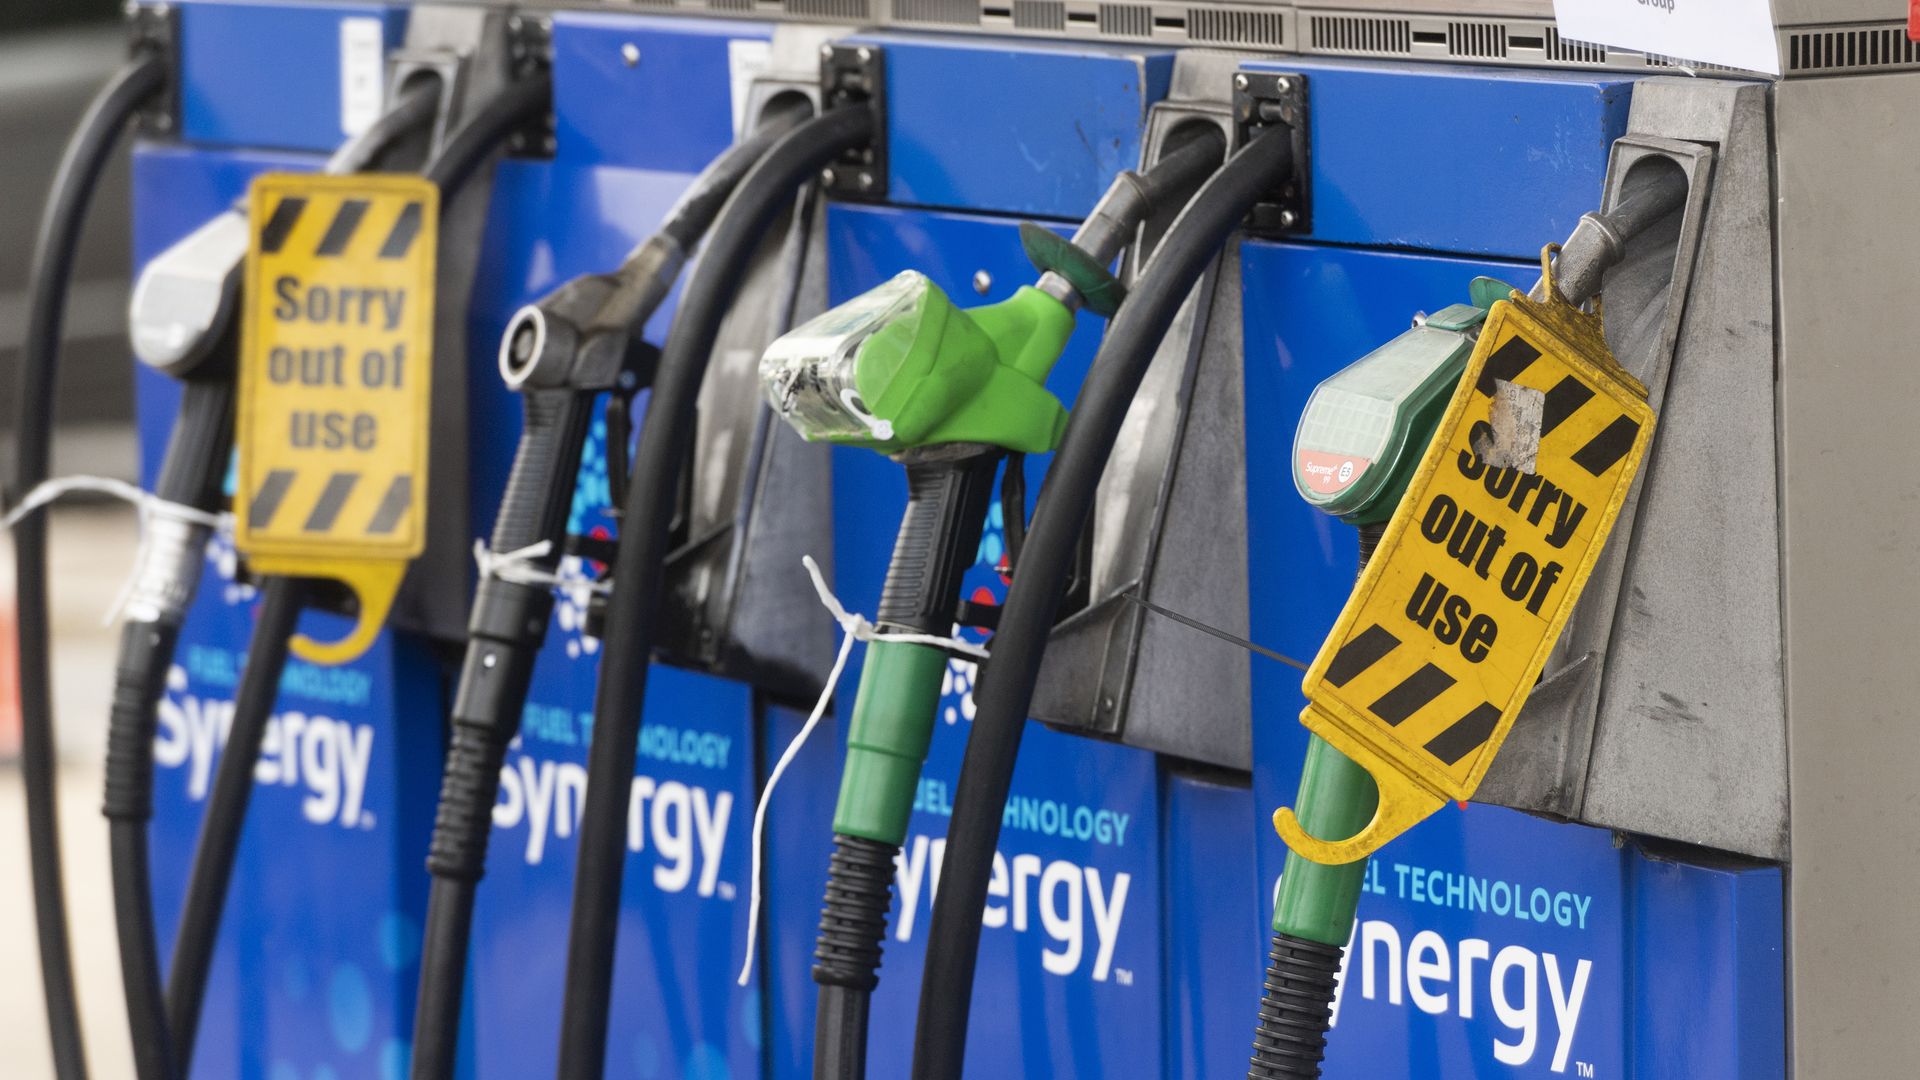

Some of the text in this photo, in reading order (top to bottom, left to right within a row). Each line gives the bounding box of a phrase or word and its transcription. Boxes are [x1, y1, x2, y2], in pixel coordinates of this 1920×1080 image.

[273, 274, 405, 332] Sorry
[268, 341, 406, 389] out of
[289, 411, 378, 451] use
[1457, 420, 1588, 549] Sorry
[1421, 494, 1564, 616] out of
[1405, 572, 1498, 663] use
[152, 664, 375, 829] Syergy
[579, 711, 732, 769] TNOLOGY
[491, 735, 733, 898] Synrgy
[913, 778, 1130, 848] UEL HNOLOGY
[893, 834, 1131, 982] yergy
[1394, 863, 1593, 930] TECHNOLOGY
[1273, 874, 1594, 1079] nergy TM
